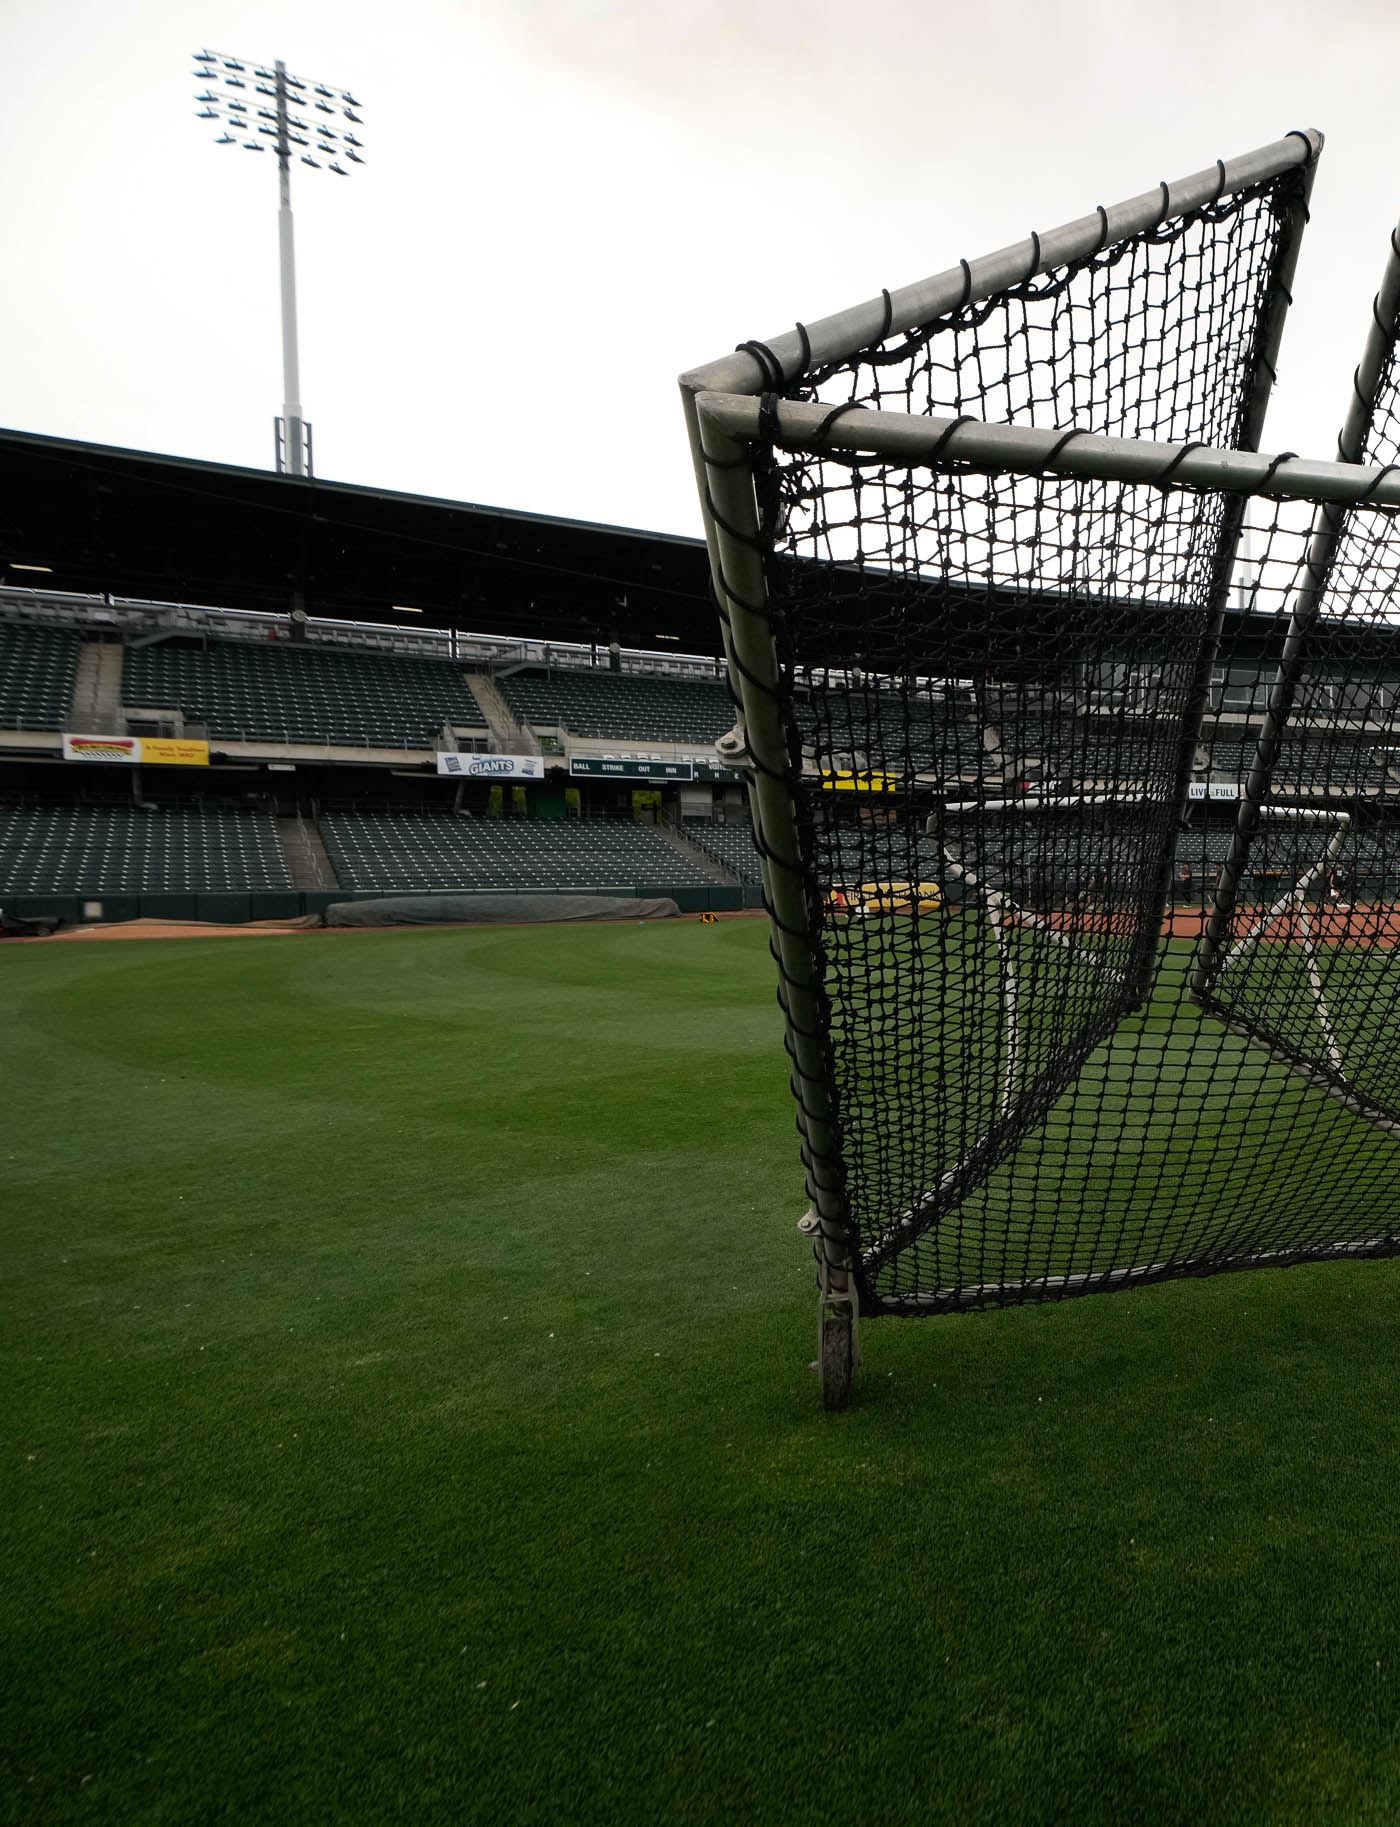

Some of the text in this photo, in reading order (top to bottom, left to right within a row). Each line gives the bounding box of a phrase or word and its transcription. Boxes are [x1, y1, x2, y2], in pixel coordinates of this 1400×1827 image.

[469, 760, 514, 776] GIANTS
[602, 764, 624, 772] STRIKE
[1215, 788, 1234, 797] FULL
